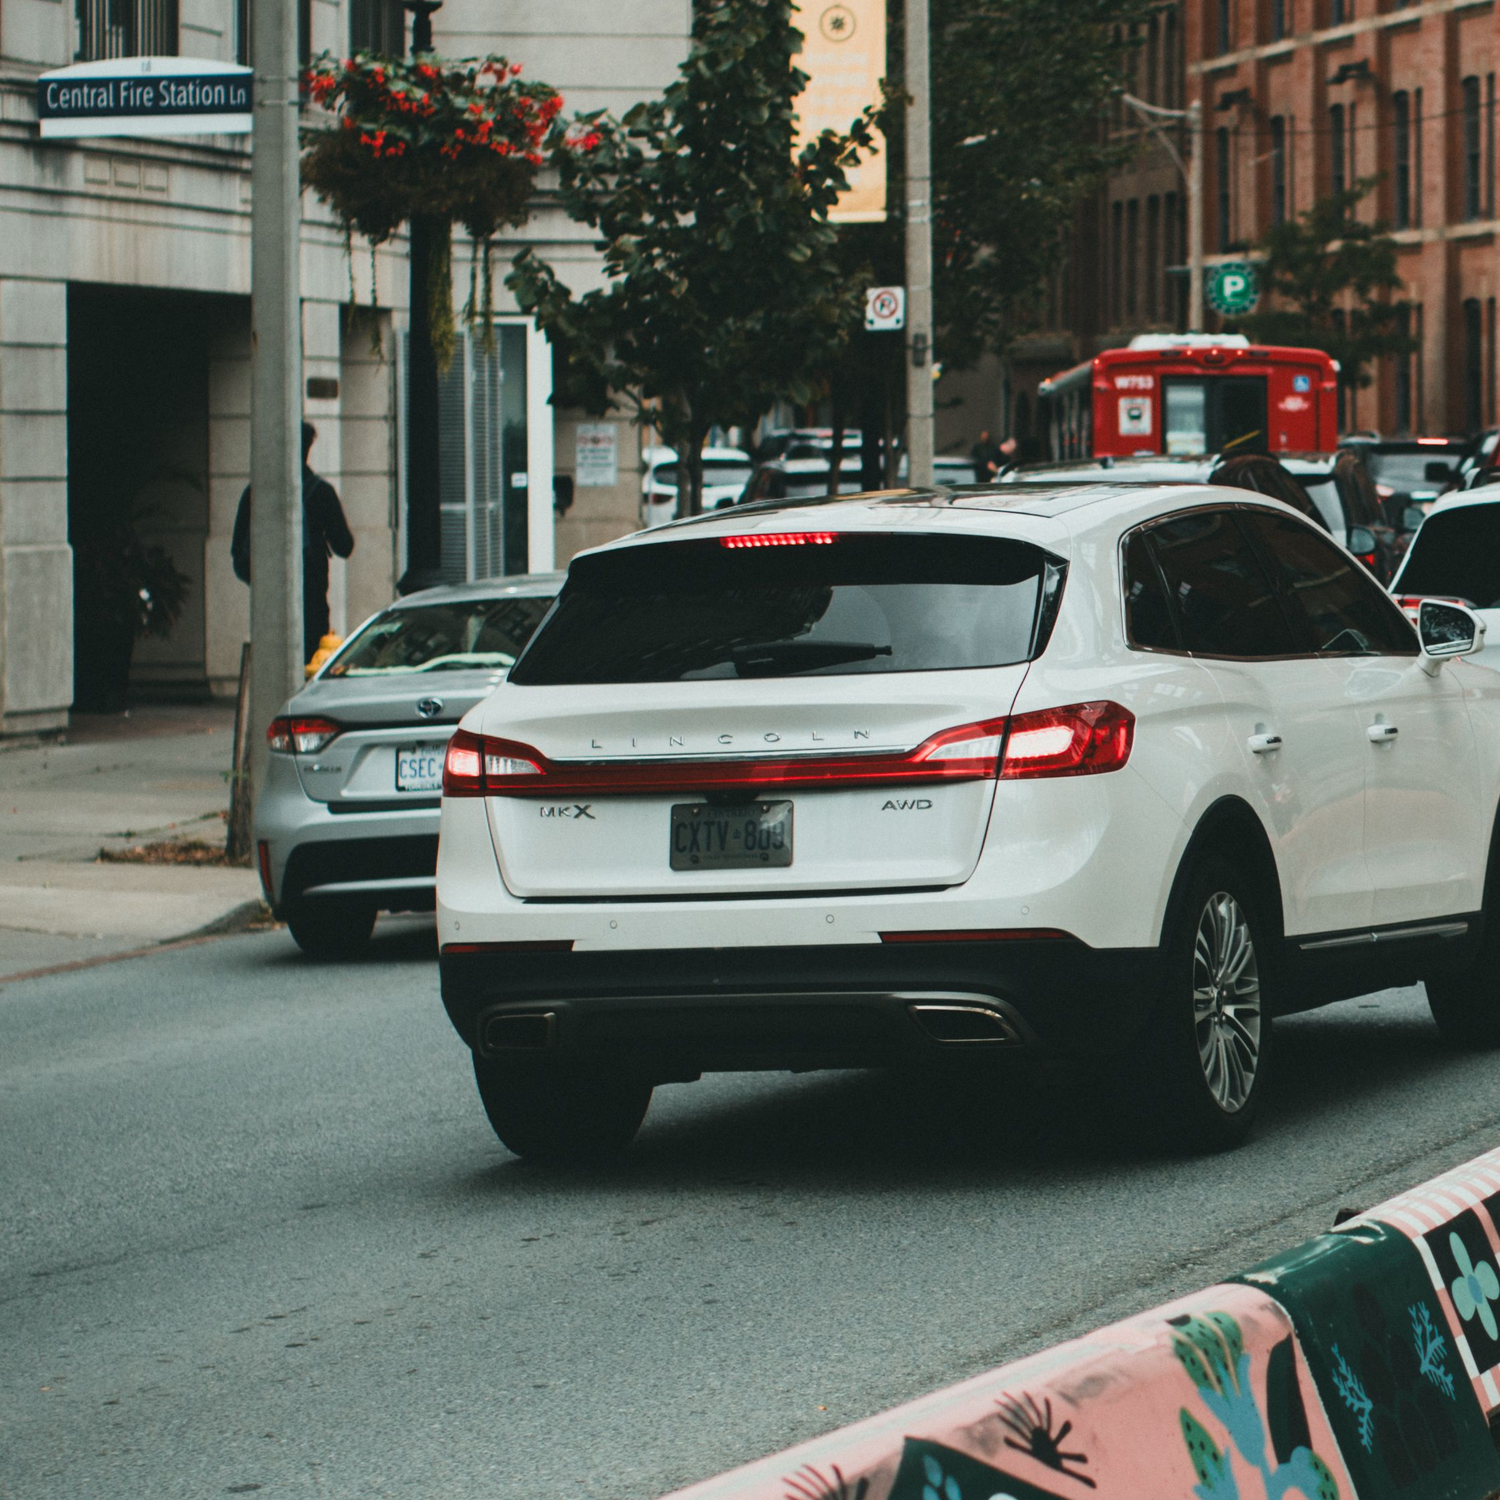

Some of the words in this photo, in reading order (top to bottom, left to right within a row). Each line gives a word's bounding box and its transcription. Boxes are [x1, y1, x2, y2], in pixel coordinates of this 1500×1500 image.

[46, 82, 115, 109] Central
[120, 81, 154, 108] Fire
[158, 79, 225, 107] Station
[229, 84, 247, 105] Ln
[1223, 275, 1245, 298] P
[591, 729, 871, 749] LINCOLN
[400, 757, 436, 779] CSEC
[540, 803, 596, 820] MKX
[881, 798, 933, 811] AWD
[674, 819, 730, 854] CXTV
